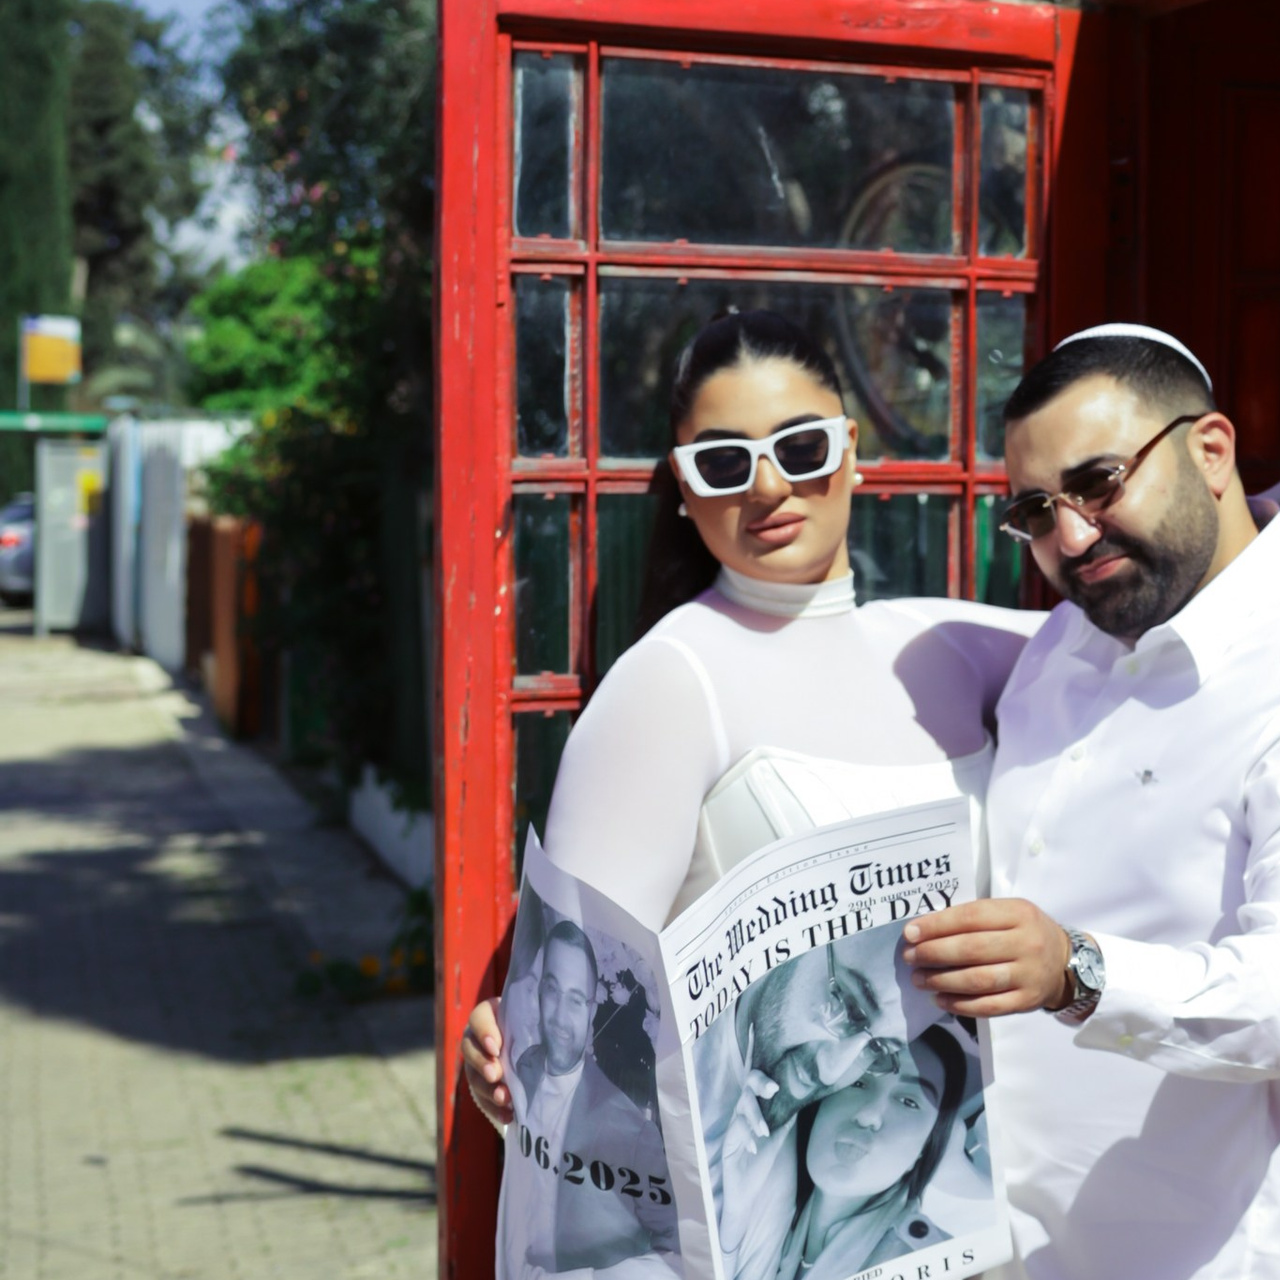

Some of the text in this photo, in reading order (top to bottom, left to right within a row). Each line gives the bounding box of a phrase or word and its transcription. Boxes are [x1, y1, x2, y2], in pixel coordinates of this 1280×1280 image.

[686, 853, 951, 1001] The Wedding Times
[690, 887, 958, 1040] TODAY IS THE DAY
[848, 896, 876, 913] 29th
[927, 877, 959, 892] 2025
